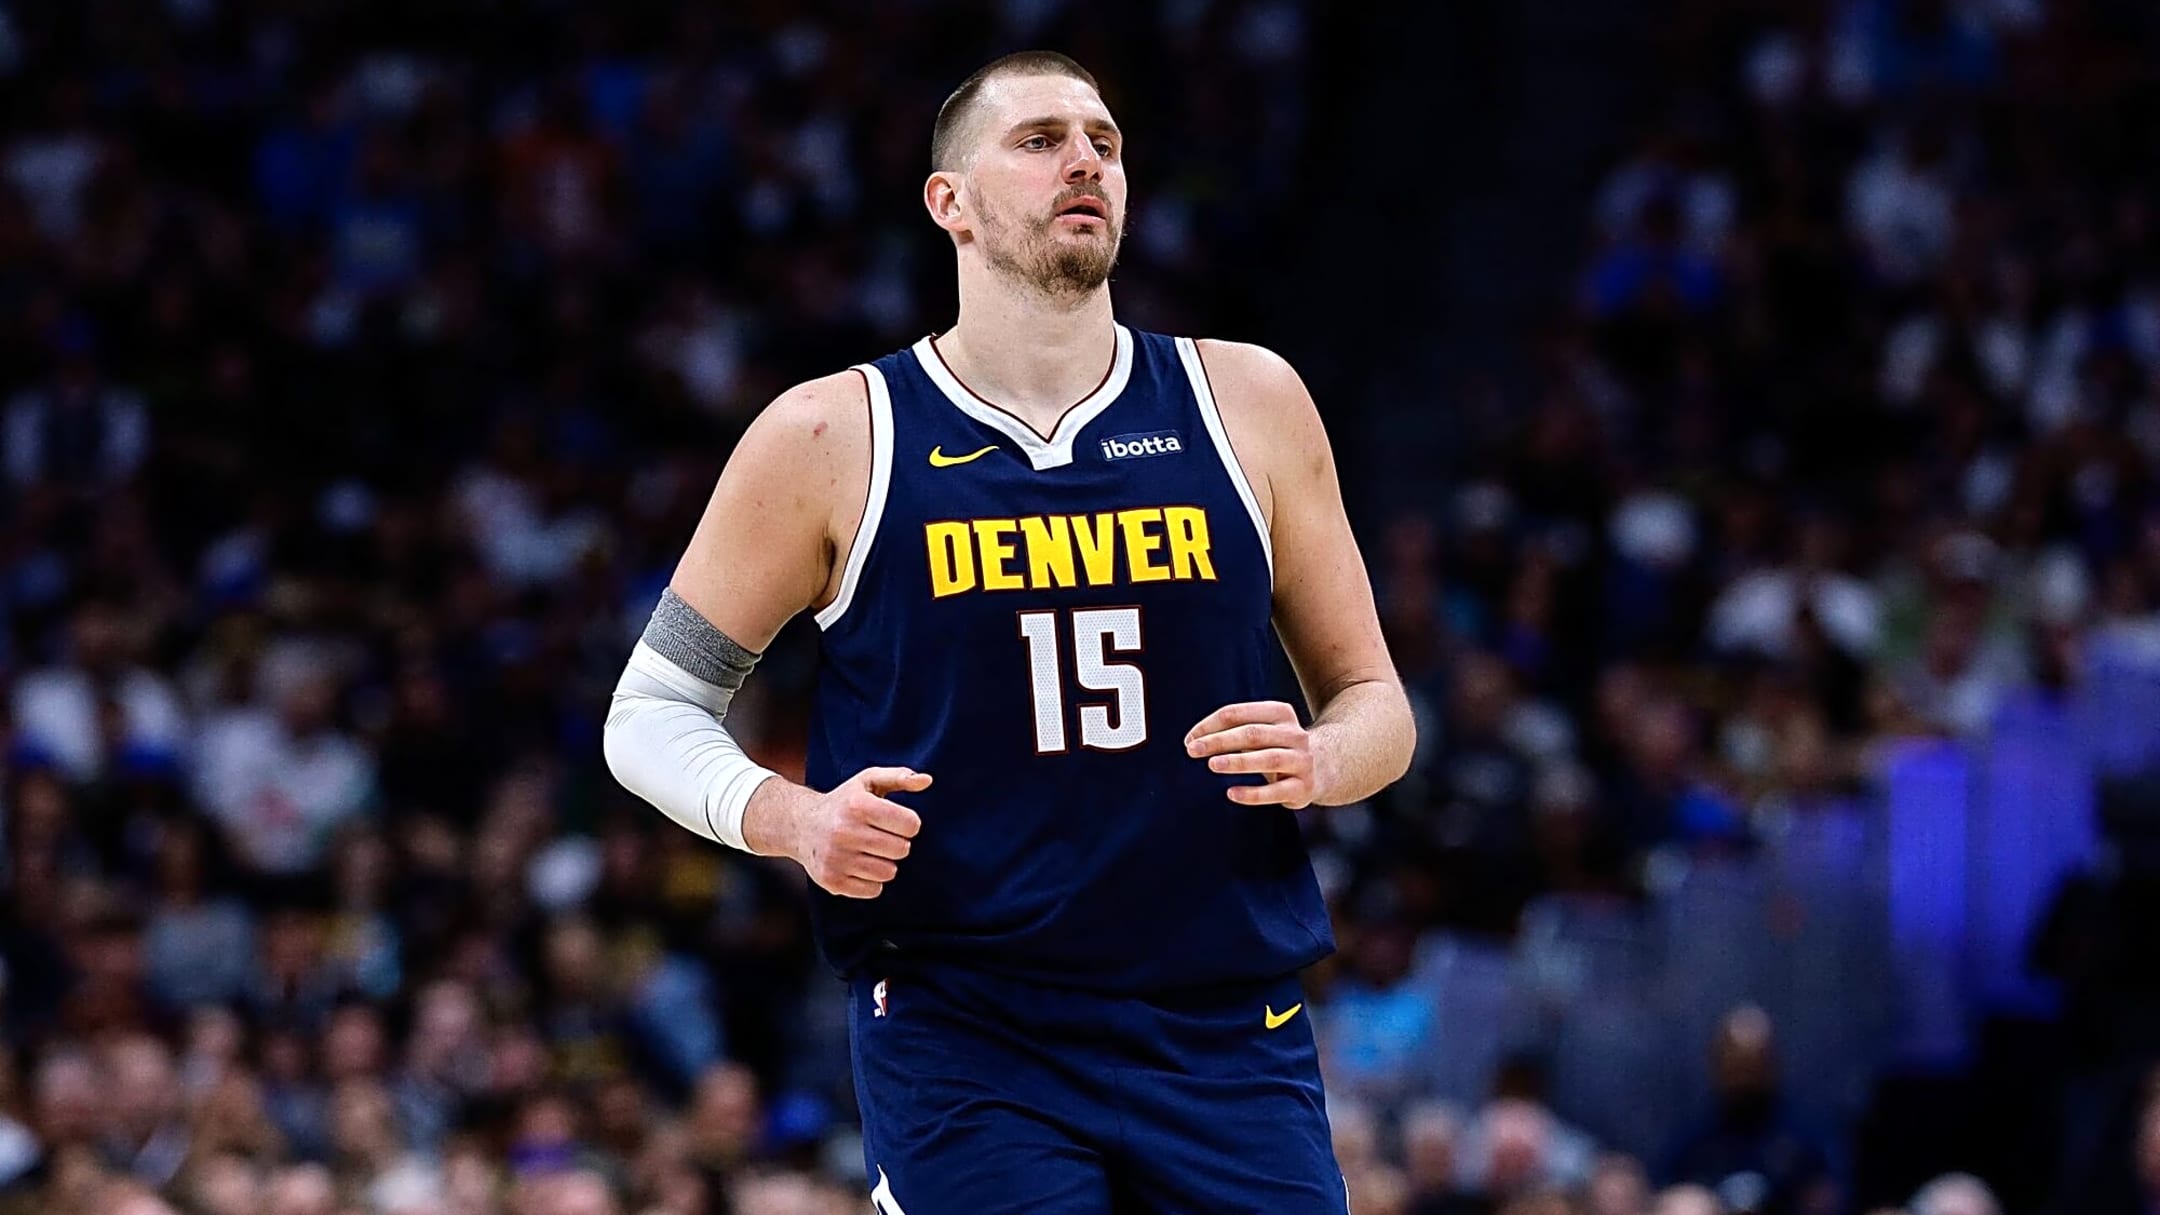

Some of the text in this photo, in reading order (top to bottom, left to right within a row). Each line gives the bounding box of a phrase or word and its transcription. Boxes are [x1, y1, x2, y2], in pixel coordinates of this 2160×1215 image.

[1101, 437, 1181, 459] ibotta
[924, 506, 1218, 599] DENVER
[1017, 605, 1148, 754] 15
